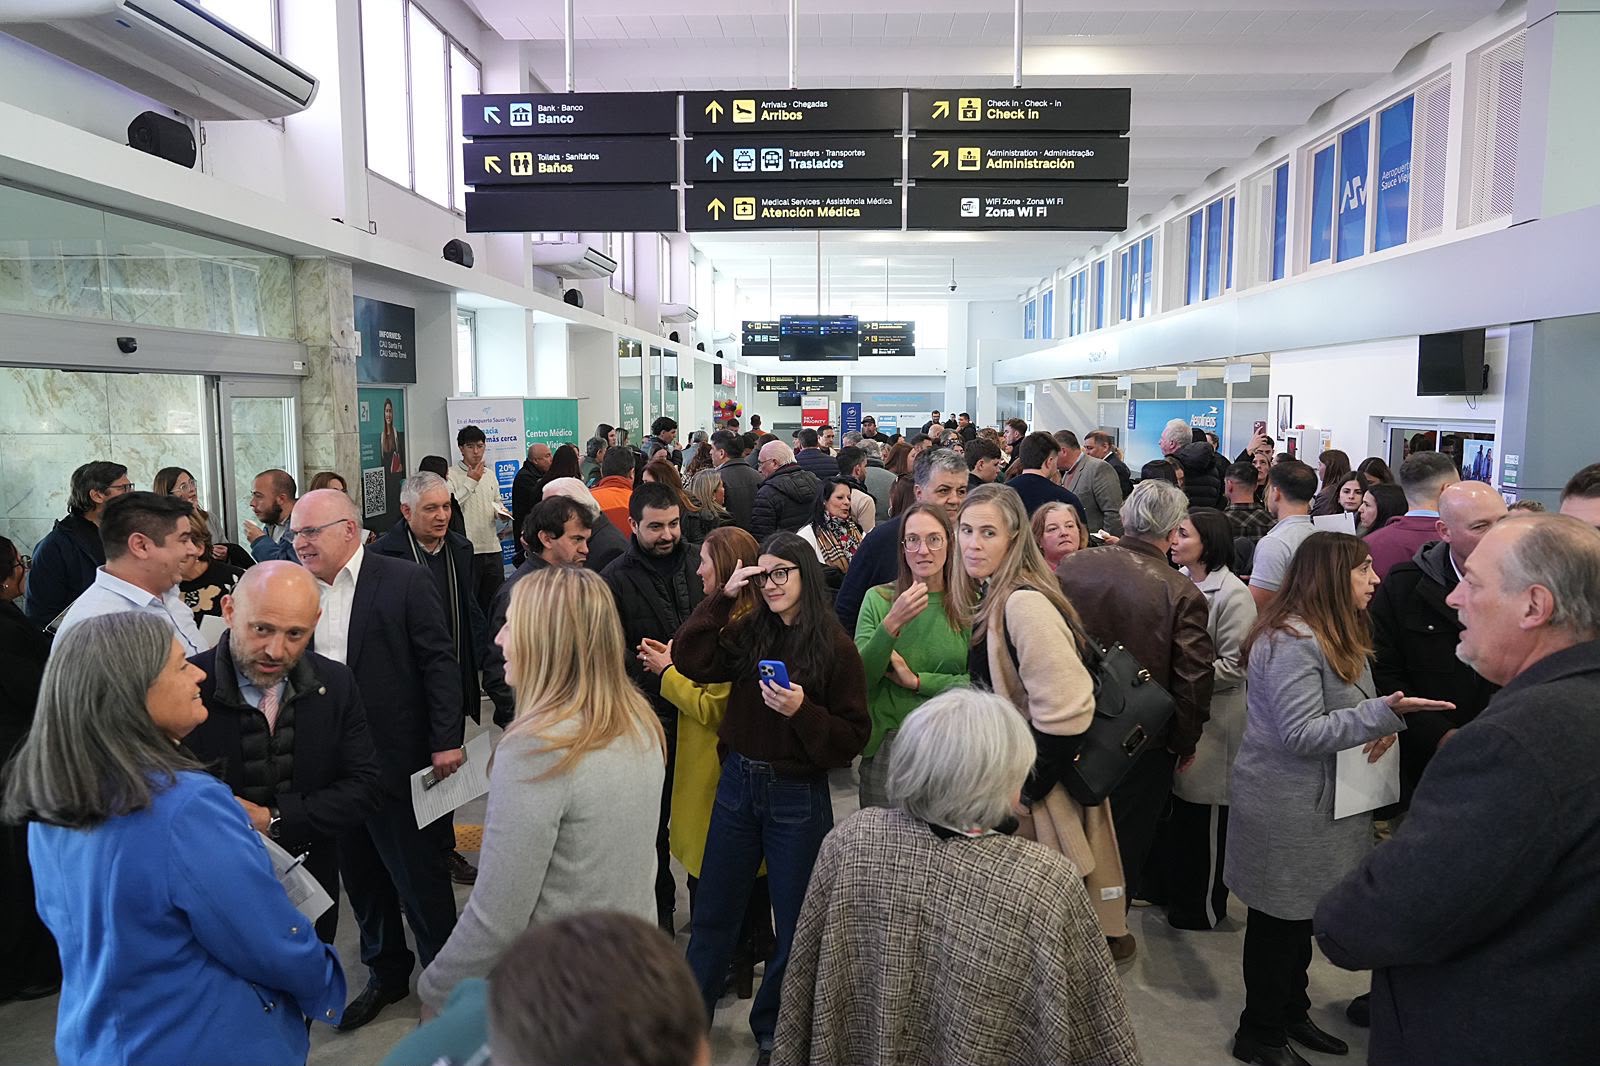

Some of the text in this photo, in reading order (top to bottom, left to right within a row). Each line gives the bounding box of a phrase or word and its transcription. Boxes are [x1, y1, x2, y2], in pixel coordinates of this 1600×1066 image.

[538, 114, 574, 124] Banco
[761, 110, 803, 121] Arribos
[987, 109, 1025, 119] Check
[826, 149, 866, 157] Transportes
[539, 162, 573, 173] Baños
[789, 159, 844, 169] Traslados
[986, 158, 1075, 169] Administración
[1382, 179, 1397, 190] Sauce
[762, 206, 860, 218] Atención Médica
[985, 207, 1015, 217] Zona
[550, 428, 572, 437] Médico
[498, 464, 515, 472] 20%
